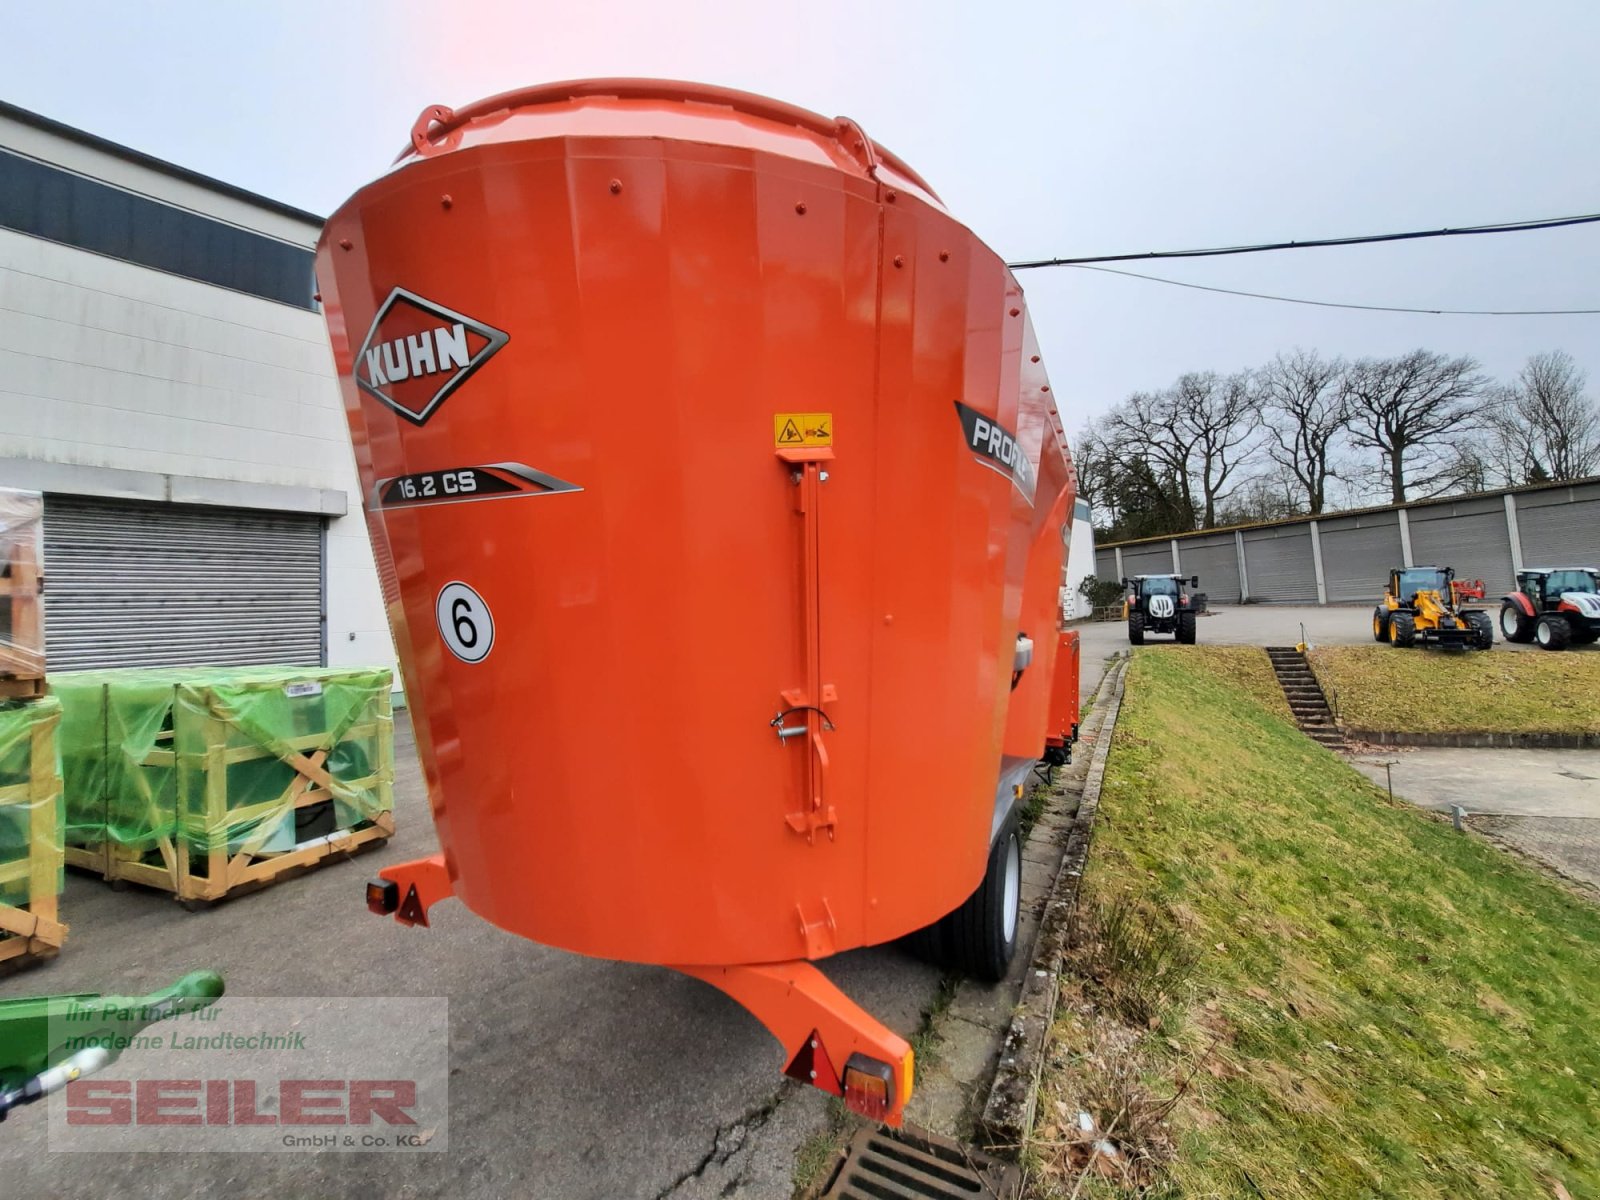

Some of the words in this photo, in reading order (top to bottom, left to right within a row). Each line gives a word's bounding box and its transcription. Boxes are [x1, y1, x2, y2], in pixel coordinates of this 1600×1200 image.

[366, 324, 470, 388] KUHN
[398, 475, 437, 499] 16.2
[443, 470, 477, 494] CS
[451, 598, 478, 648] 6
